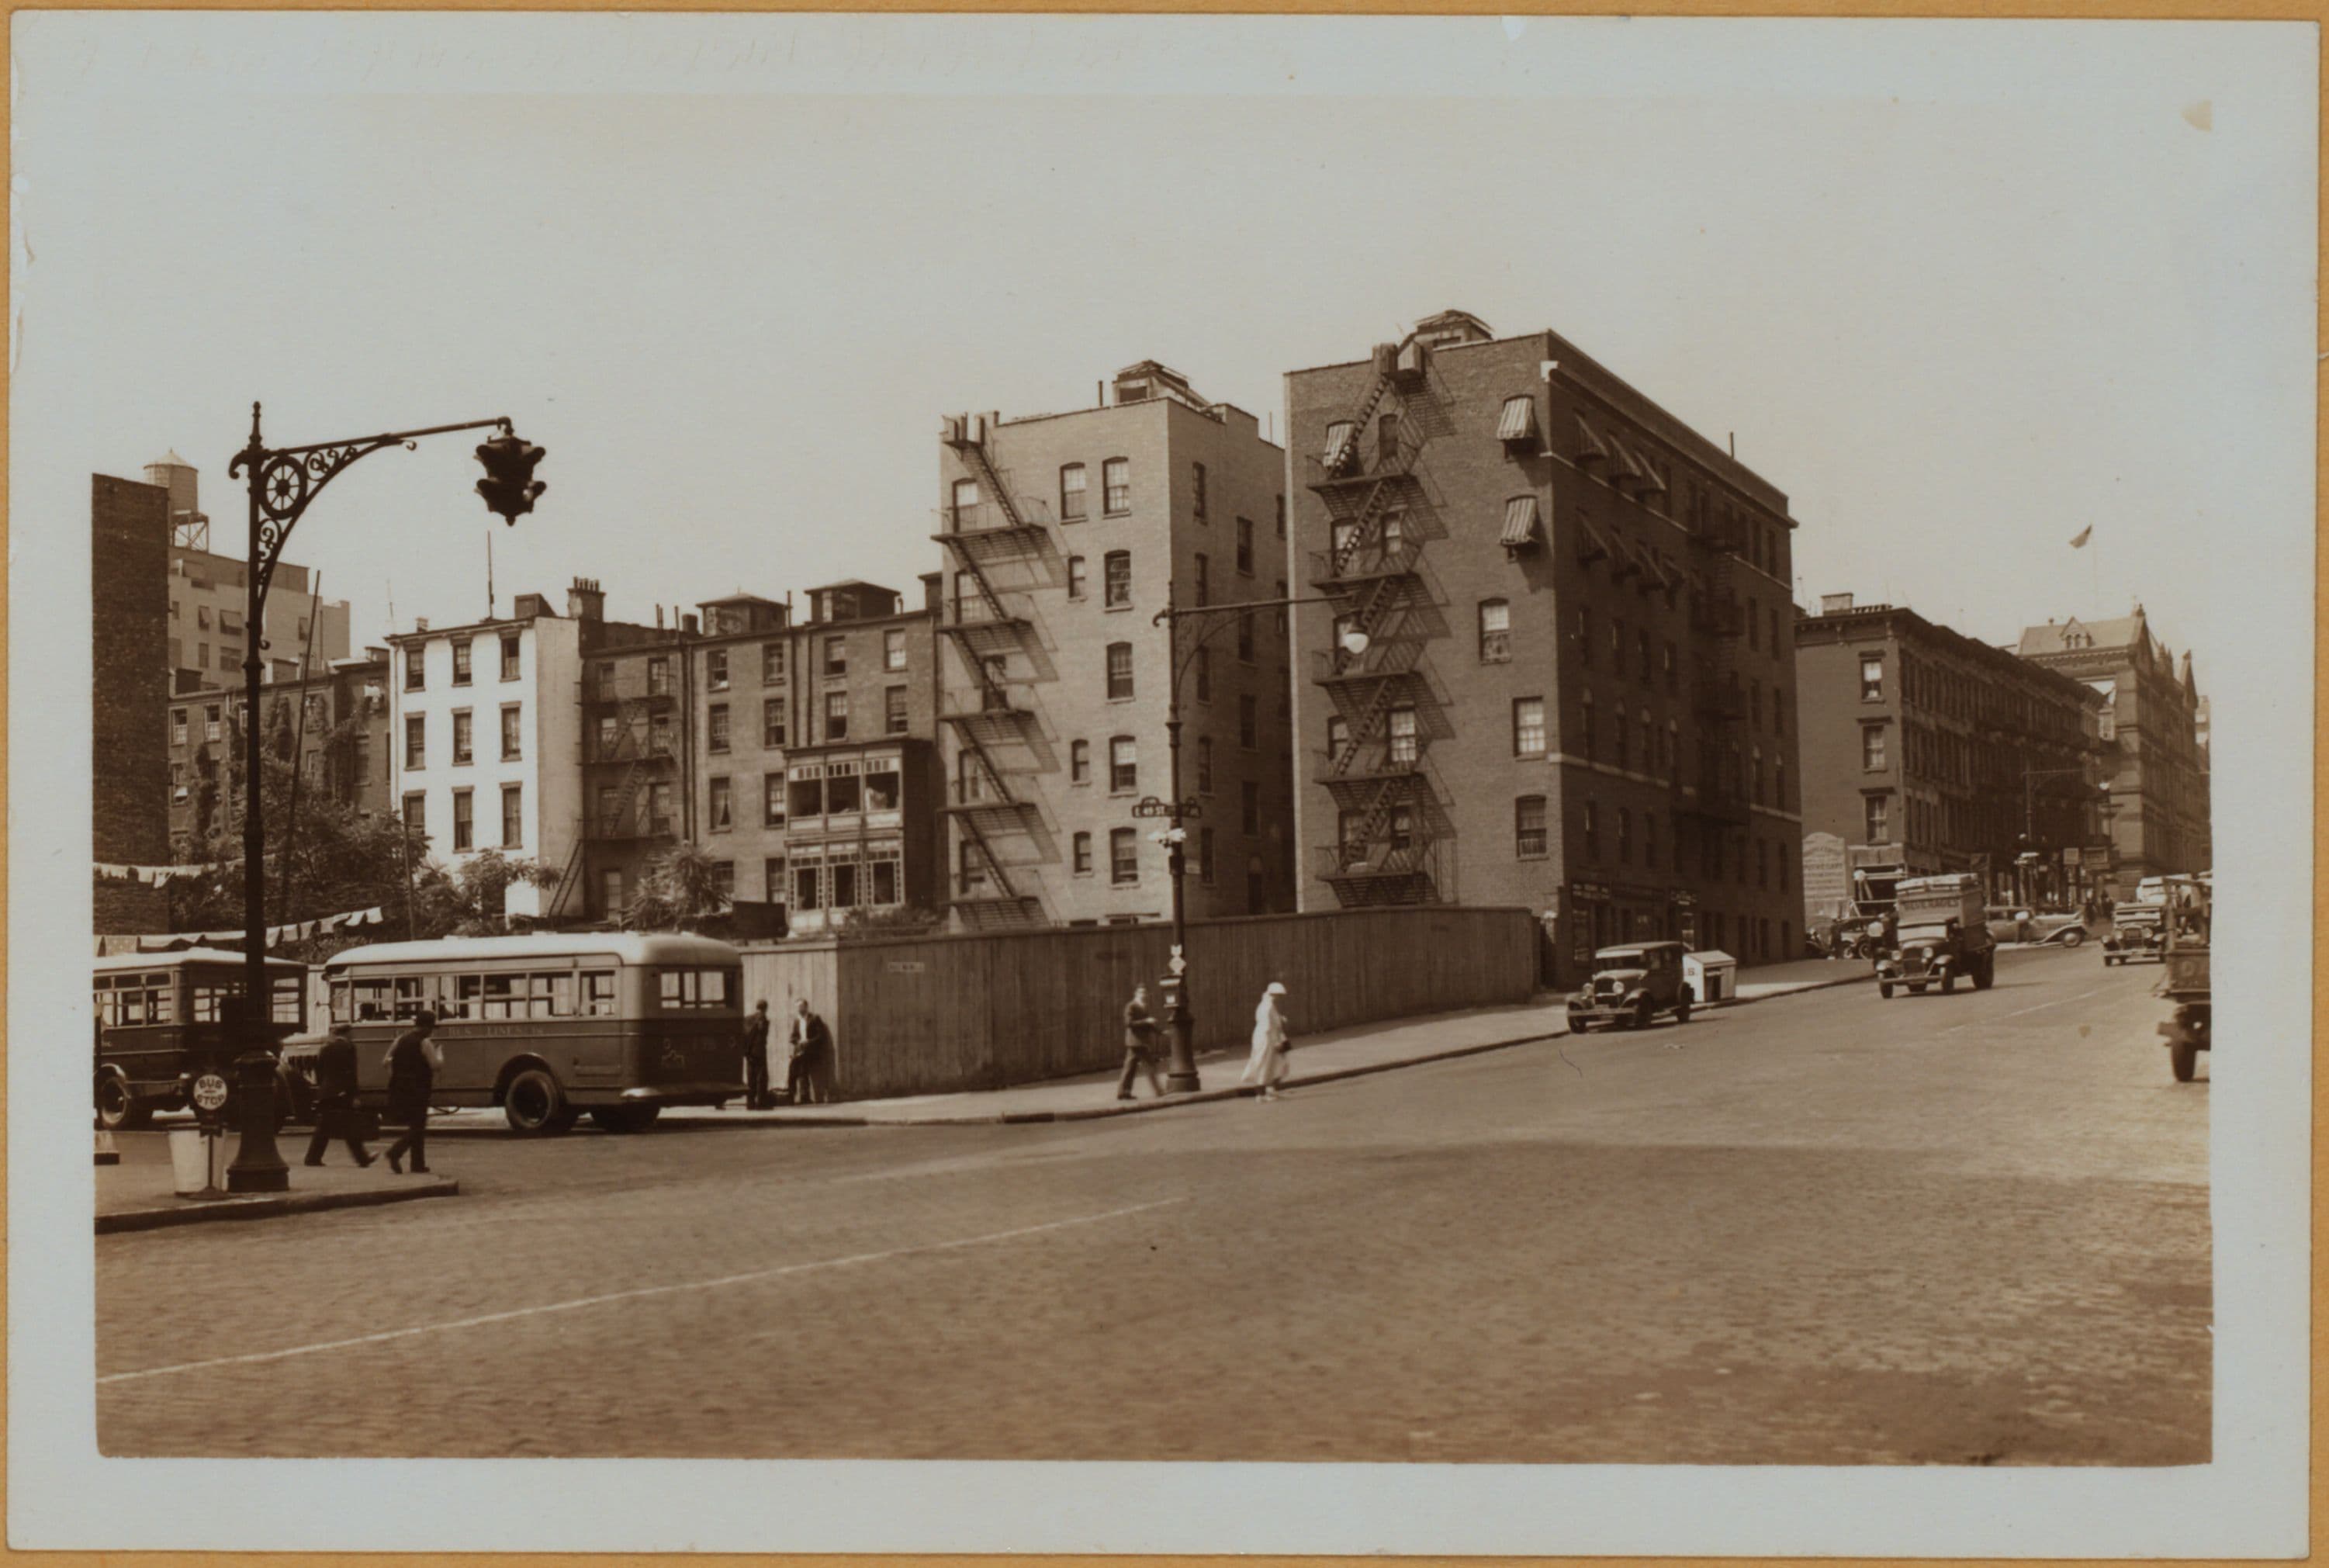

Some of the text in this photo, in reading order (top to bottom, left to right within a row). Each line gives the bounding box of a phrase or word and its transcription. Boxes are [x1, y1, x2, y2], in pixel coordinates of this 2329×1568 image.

[448, 1026, 472, 1037] BUS
[486, 1024, 522, 1037] LINES
[198, 1078, 224, 1089] BUS
[196, 1094, 225, 1106] STOP
